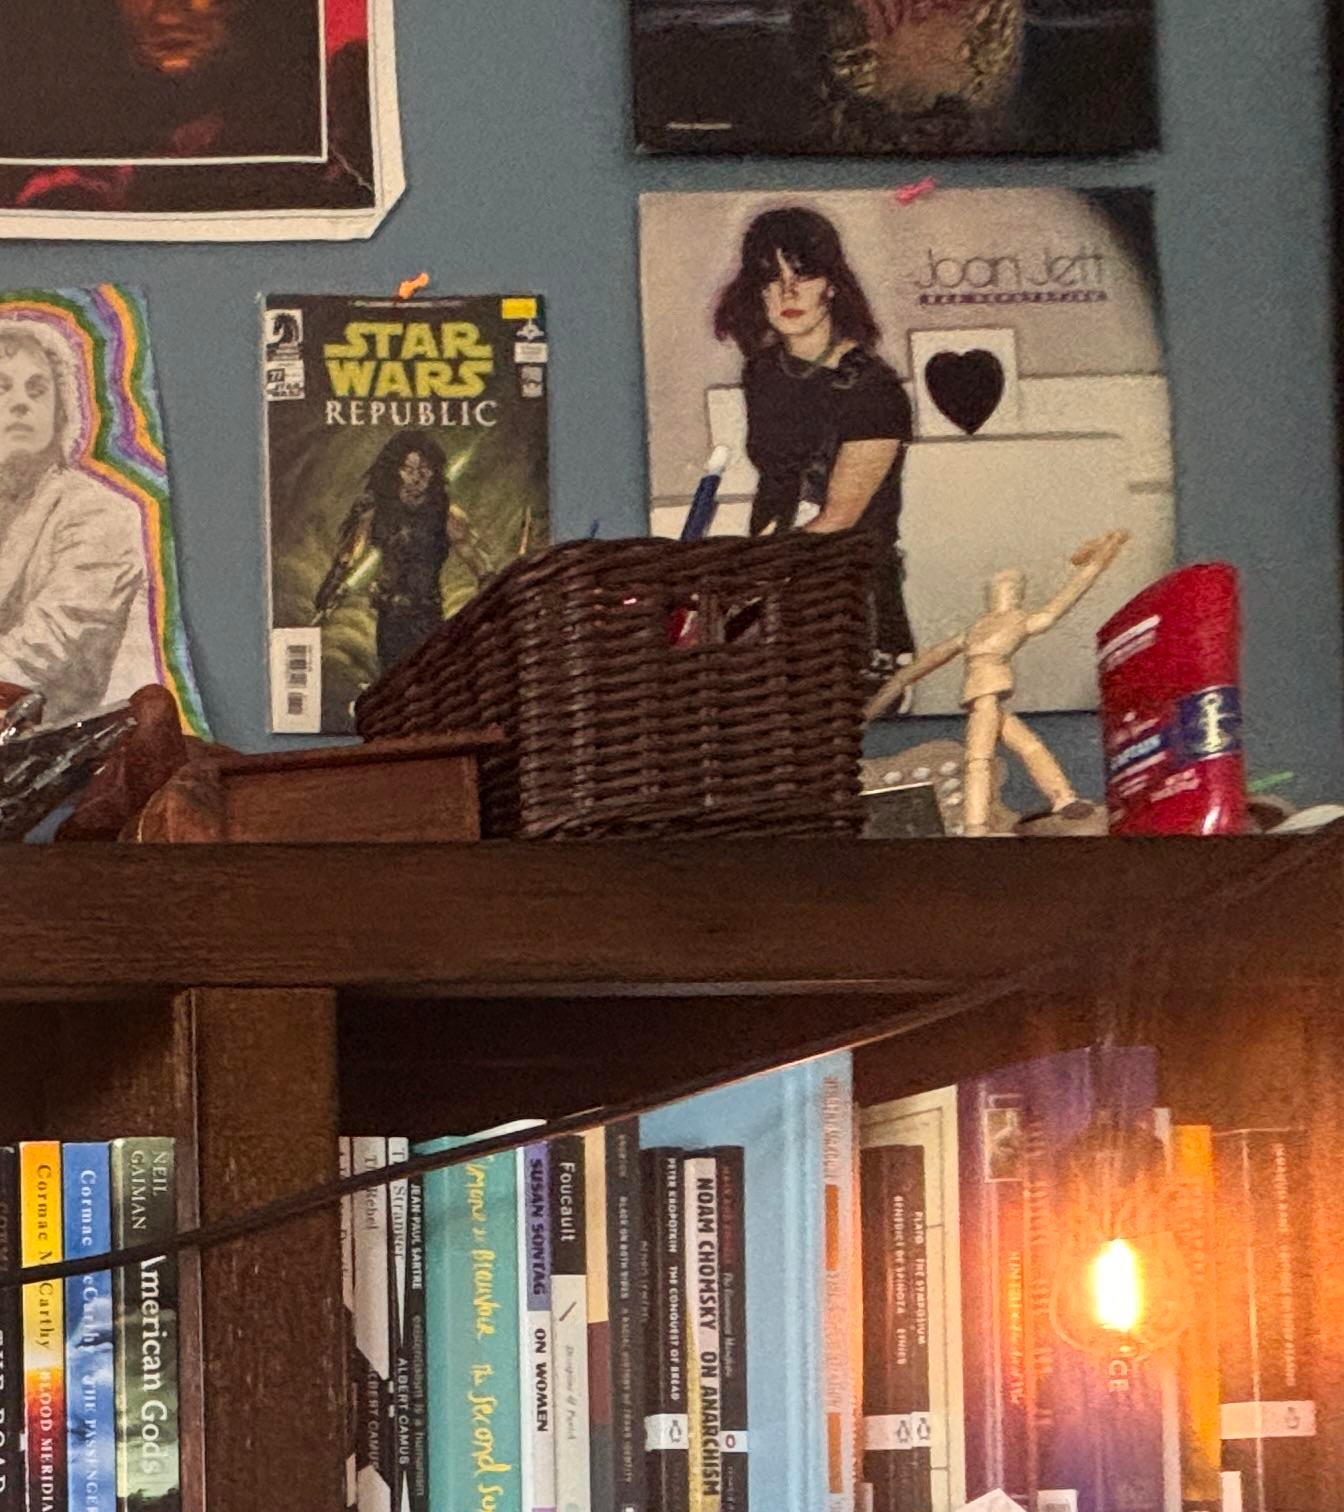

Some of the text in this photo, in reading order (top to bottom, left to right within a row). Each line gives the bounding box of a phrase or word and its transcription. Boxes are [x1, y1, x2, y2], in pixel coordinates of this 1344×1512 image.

[324, 321, 493, 360] STAR
[324, 359, 494, 398] WARS
[326, 400, 499, 437] REPUBLIC
[36, 1163, 52, 1242] Cormac
[130, 1150, 146, 1231] GAIMAN
[152, 1150, 166, 1197] NEIL
[559, 1161, 576, 1242] Foucault
[529, 1157, 548, 1432] SUSAN SONTAG ON WOMEN
[139, 1255, 167, 1476] American Gods
[696, 1177, 721, 1497] NOAM CHOMSKY ON ANARCHISM
[37, 1369, 52, 1432] BLOOD
